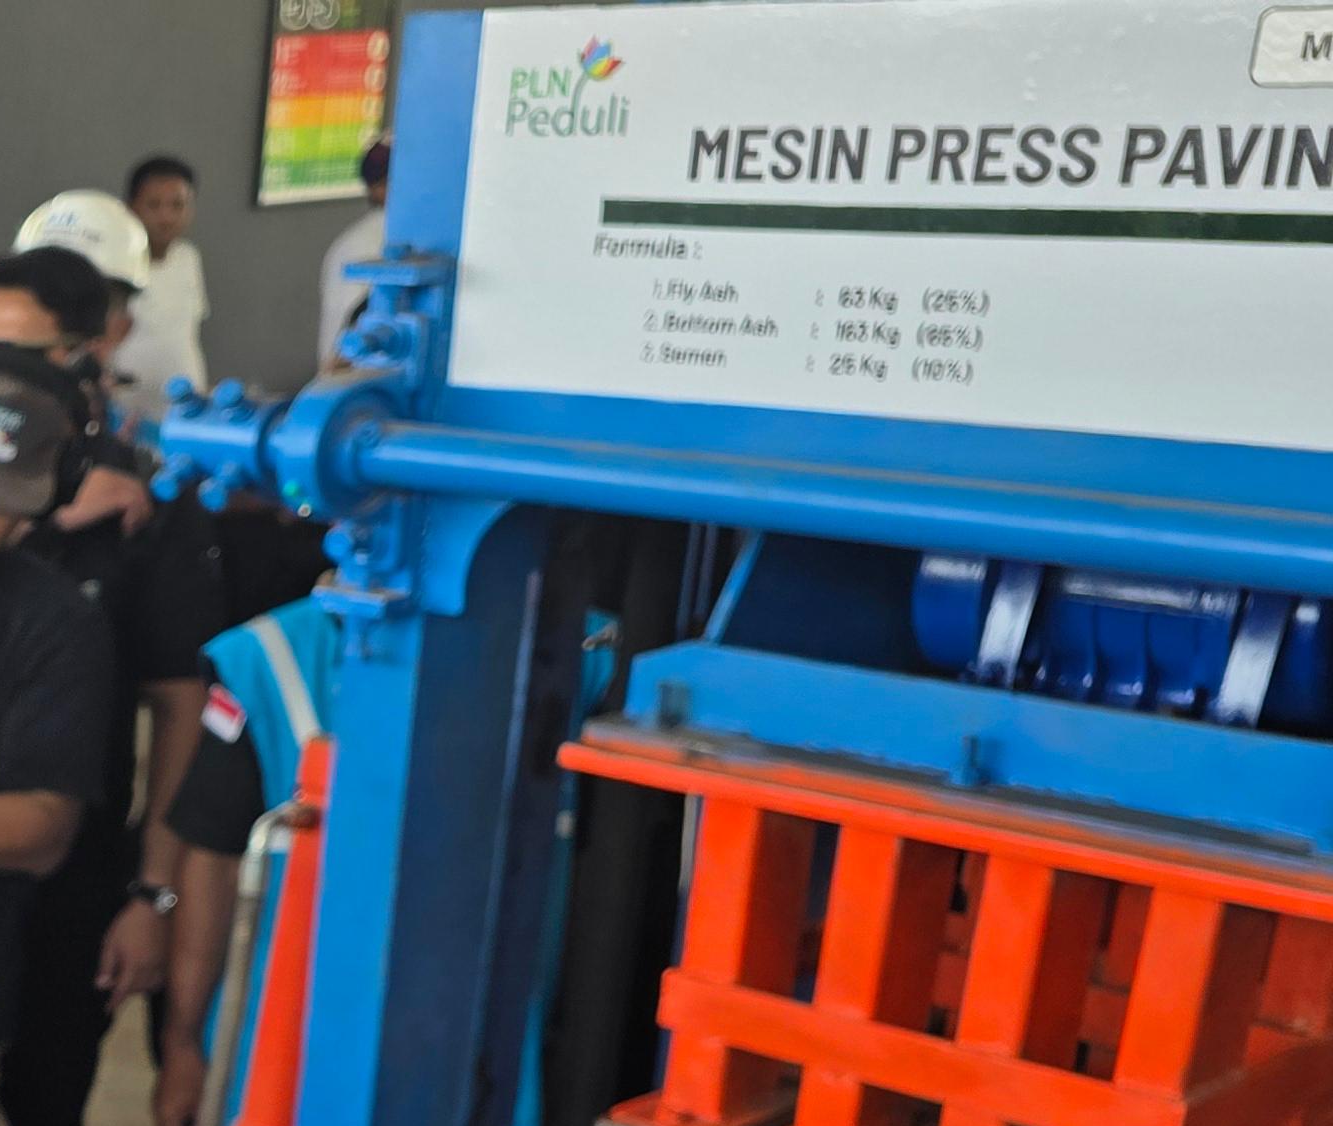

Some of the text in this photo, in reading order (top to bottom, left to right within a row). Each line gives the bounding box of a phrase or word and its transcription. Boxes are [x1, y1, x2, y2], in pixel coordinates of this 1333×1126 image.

[510, 66, 572, 98] PLN
[505, 92, 631, 137] Peduli
[687, 125, 1333, 189] MESIN PRESS PAVIN
[593, 233, 688, 260] Formula
[699, 279, 739, 303] Ash
[868, 286, 899, 315] Kg
[738, 313, 779, 338] Ash
[871, 321, 901, 350] Kg
[859, 353, 888, 383] Kg
[911, 355, 974, 385] (10%)
